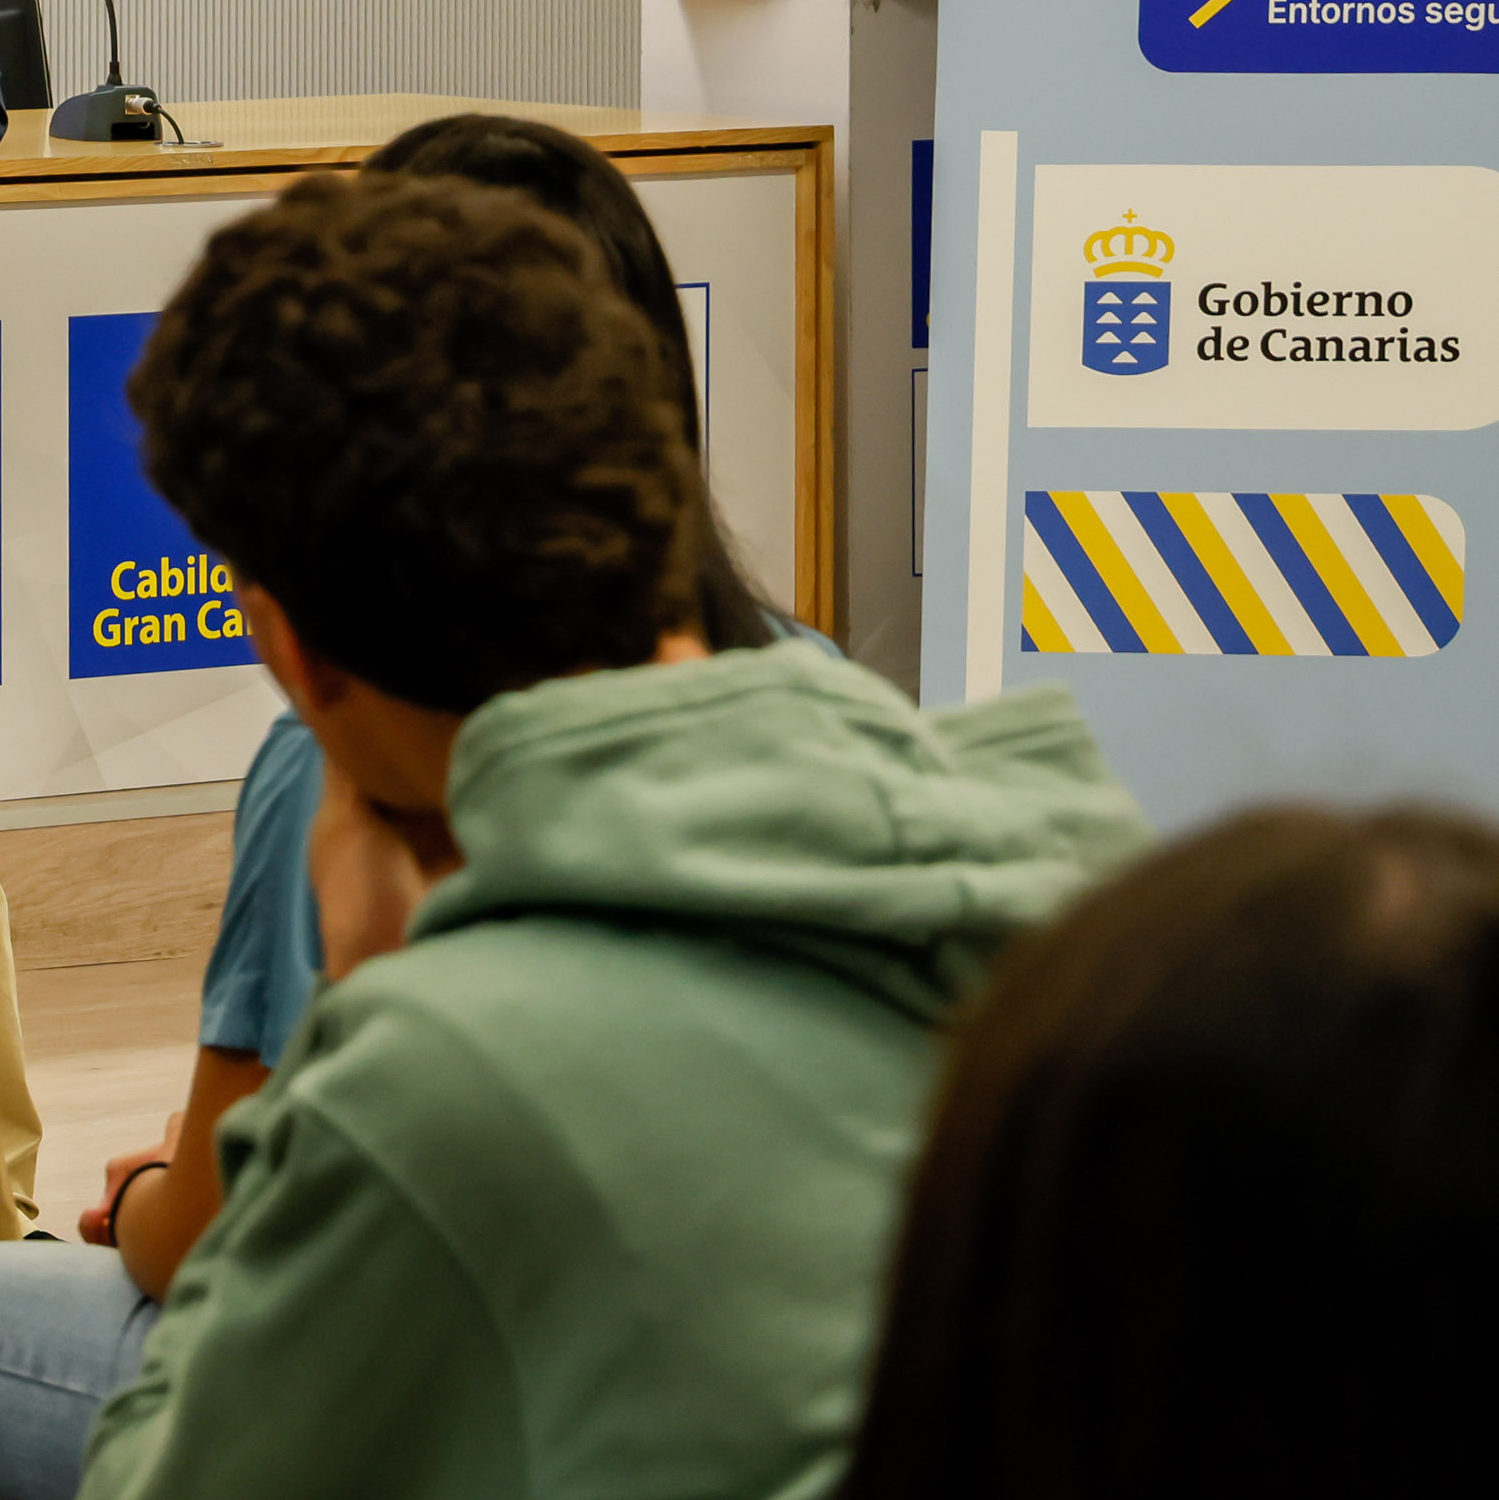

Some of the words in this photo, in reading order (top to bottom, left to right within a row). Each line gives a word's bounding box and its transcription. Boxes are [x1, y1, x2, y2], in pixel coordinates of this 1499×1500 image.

[1198, 281, 1413, 317] Gobierno
[1197, 326, 1249, 361] de
[1260, 327, 1460, 363] Canarias
[110, 553, 233, 600] Cabild
[93, 610, 186, 647] Gran
